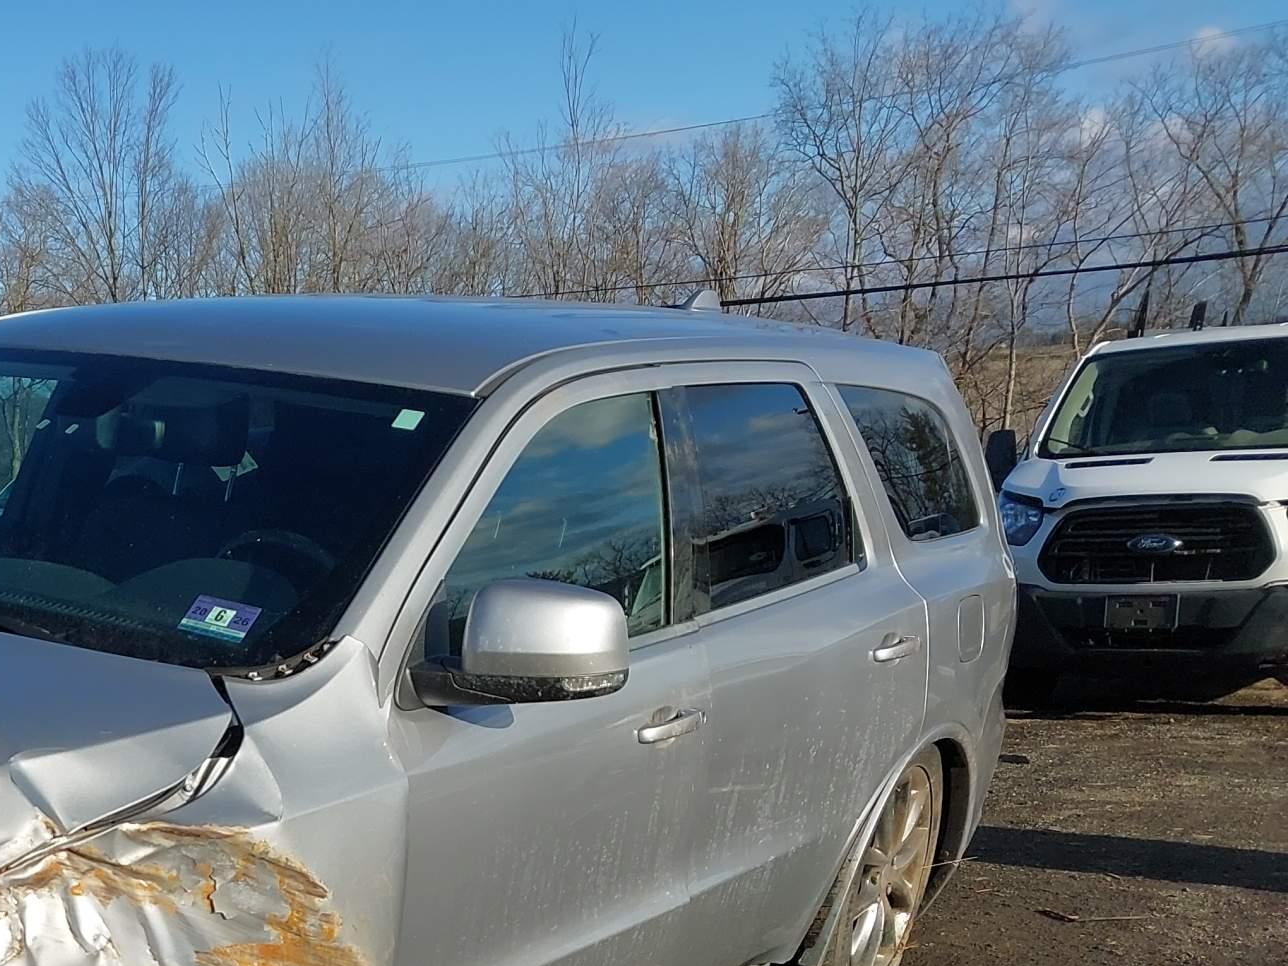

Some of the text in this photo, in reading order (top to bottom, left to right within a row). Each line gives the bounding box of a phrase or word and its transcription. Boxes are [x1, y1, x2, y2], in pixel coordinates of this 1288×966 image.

[1137, 537, 1167, 549] Ford
[192, 606, 207, 616] 20
[233, 616, 249, 626] 26
